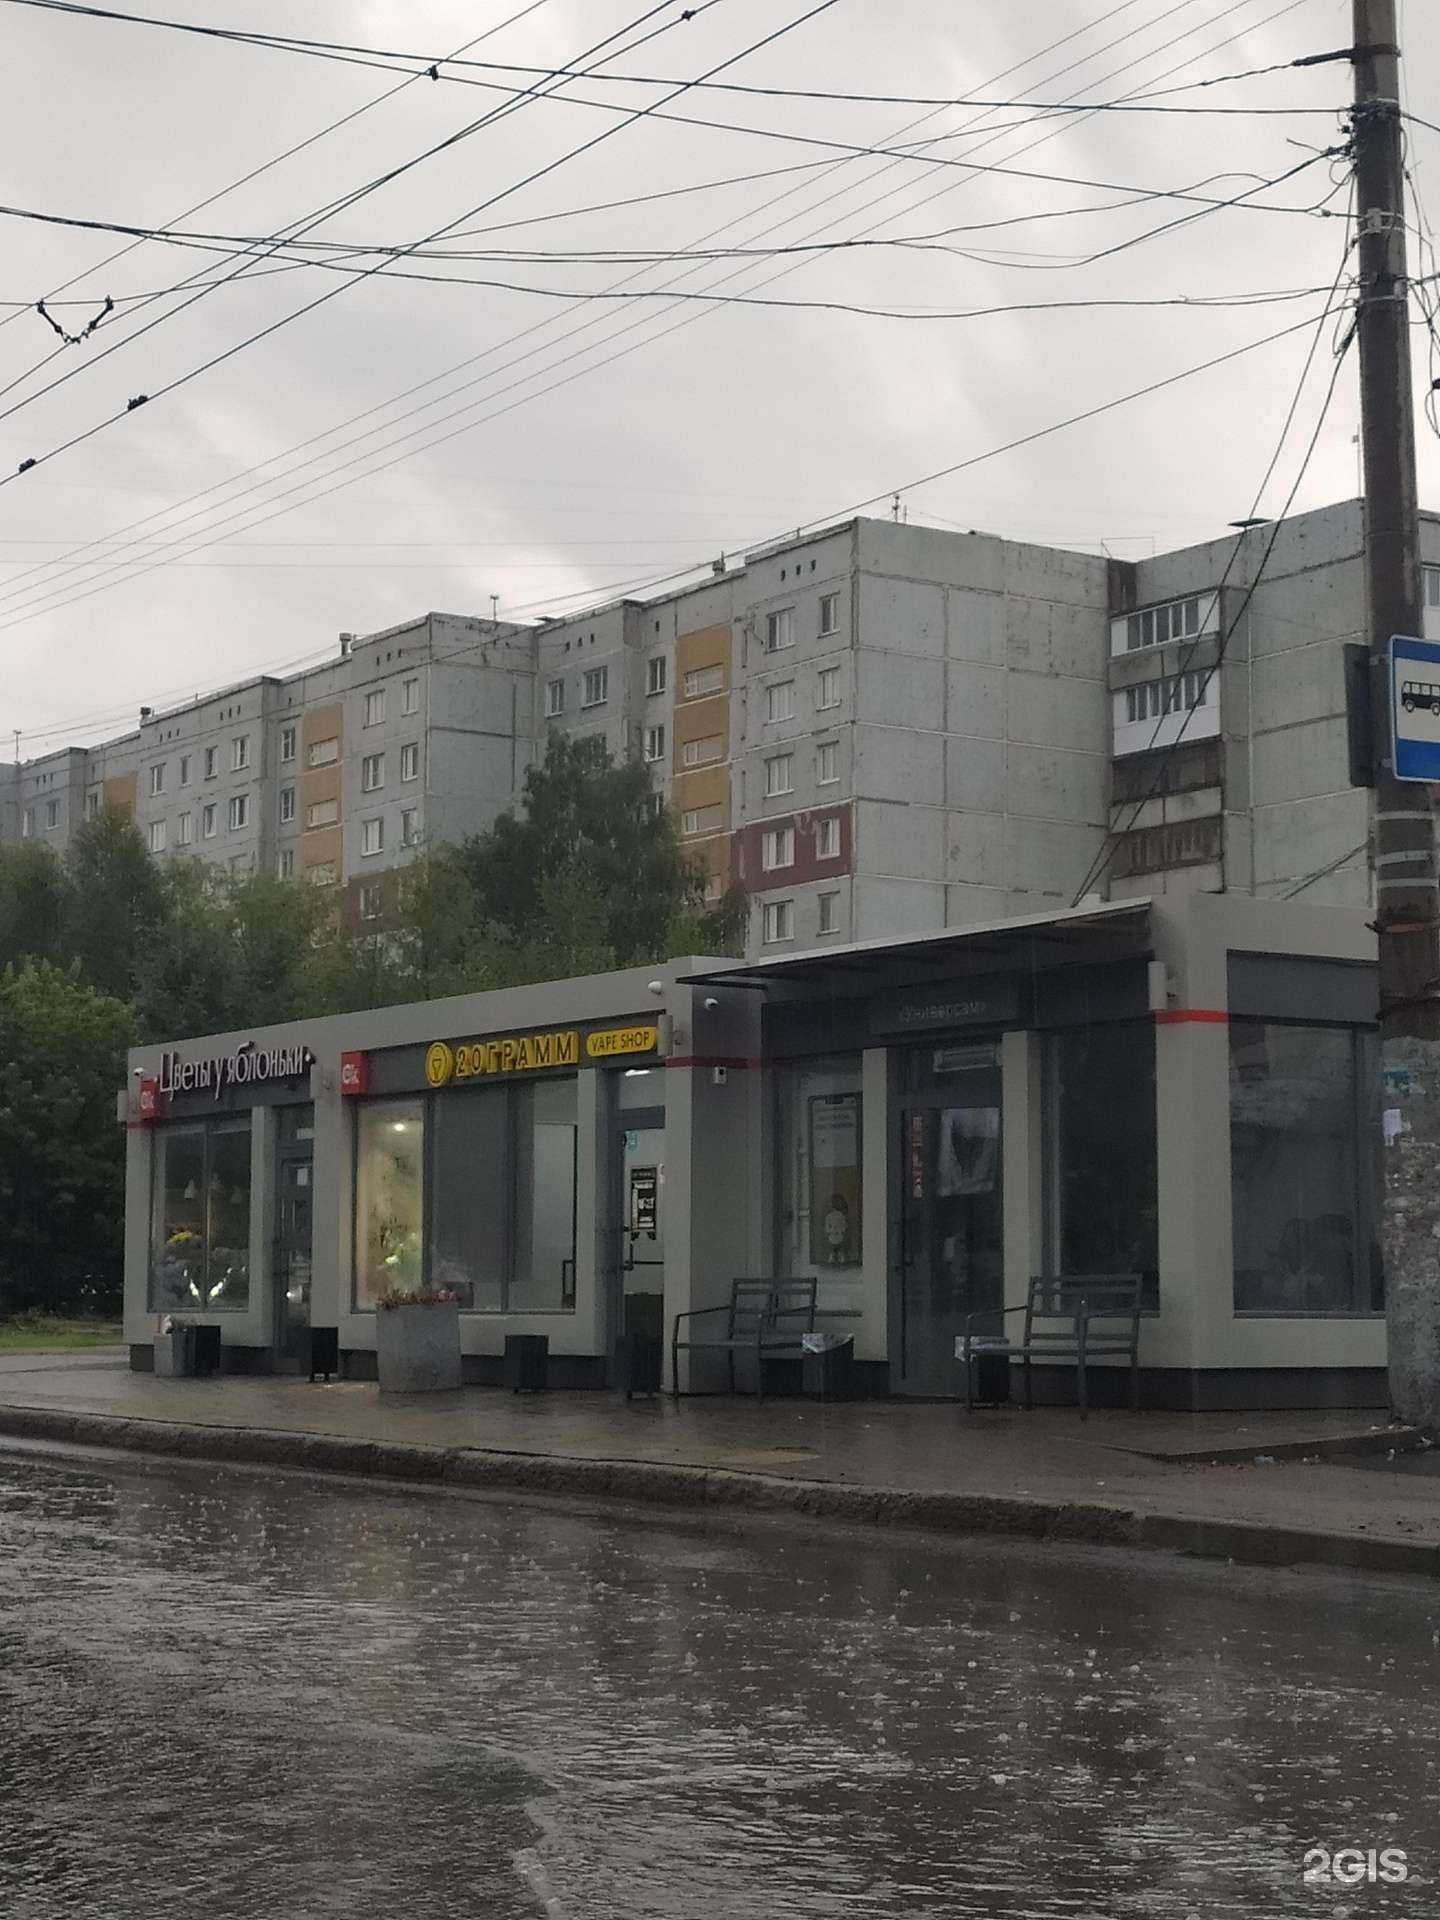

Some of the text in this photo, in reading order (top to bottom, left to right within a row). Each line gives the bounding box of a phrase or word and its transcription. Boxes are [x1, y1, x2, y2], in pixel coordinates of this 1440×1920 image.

[591, 1031, 650, 1052] VAPE SHOP
[160, 1041, 304, 1101] Цветы у яблоньки
